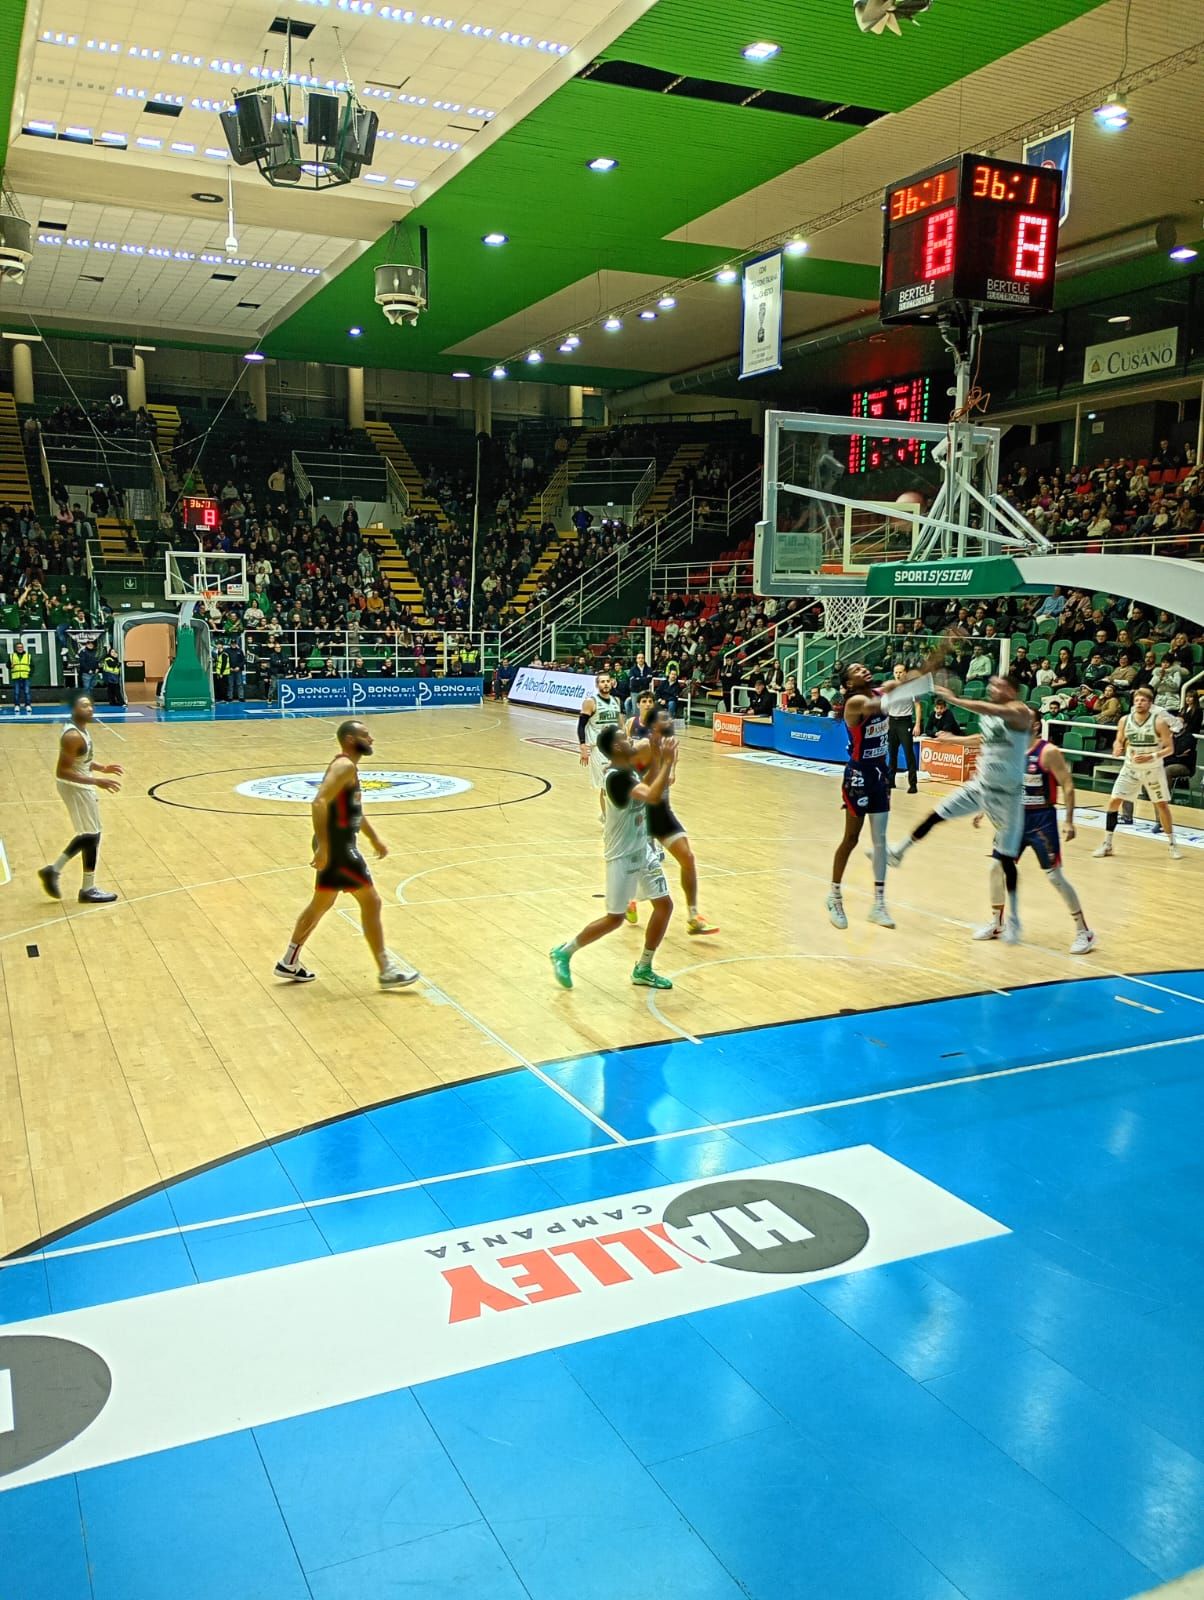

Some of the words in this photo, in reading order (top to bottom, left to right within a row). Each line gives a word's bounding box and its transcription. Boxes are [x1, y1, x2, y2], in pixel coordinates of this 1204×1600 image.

[924, 208, 955, 279] 8
[1014, 213, 1048, 280] 8
[1107, 347, 1173, 375] CUSANO
[204, 509, 216, 526] 8
[298, 686, 330, 694] BONO
[368, 685, 400, 693] BONO
[932, 751, 963, 764] DURING
[851, 777, 865, 787] 22
[424, 1204, 653, 1260] CAMPANIA
[441, 1199, 816, 1325] HALLEY
